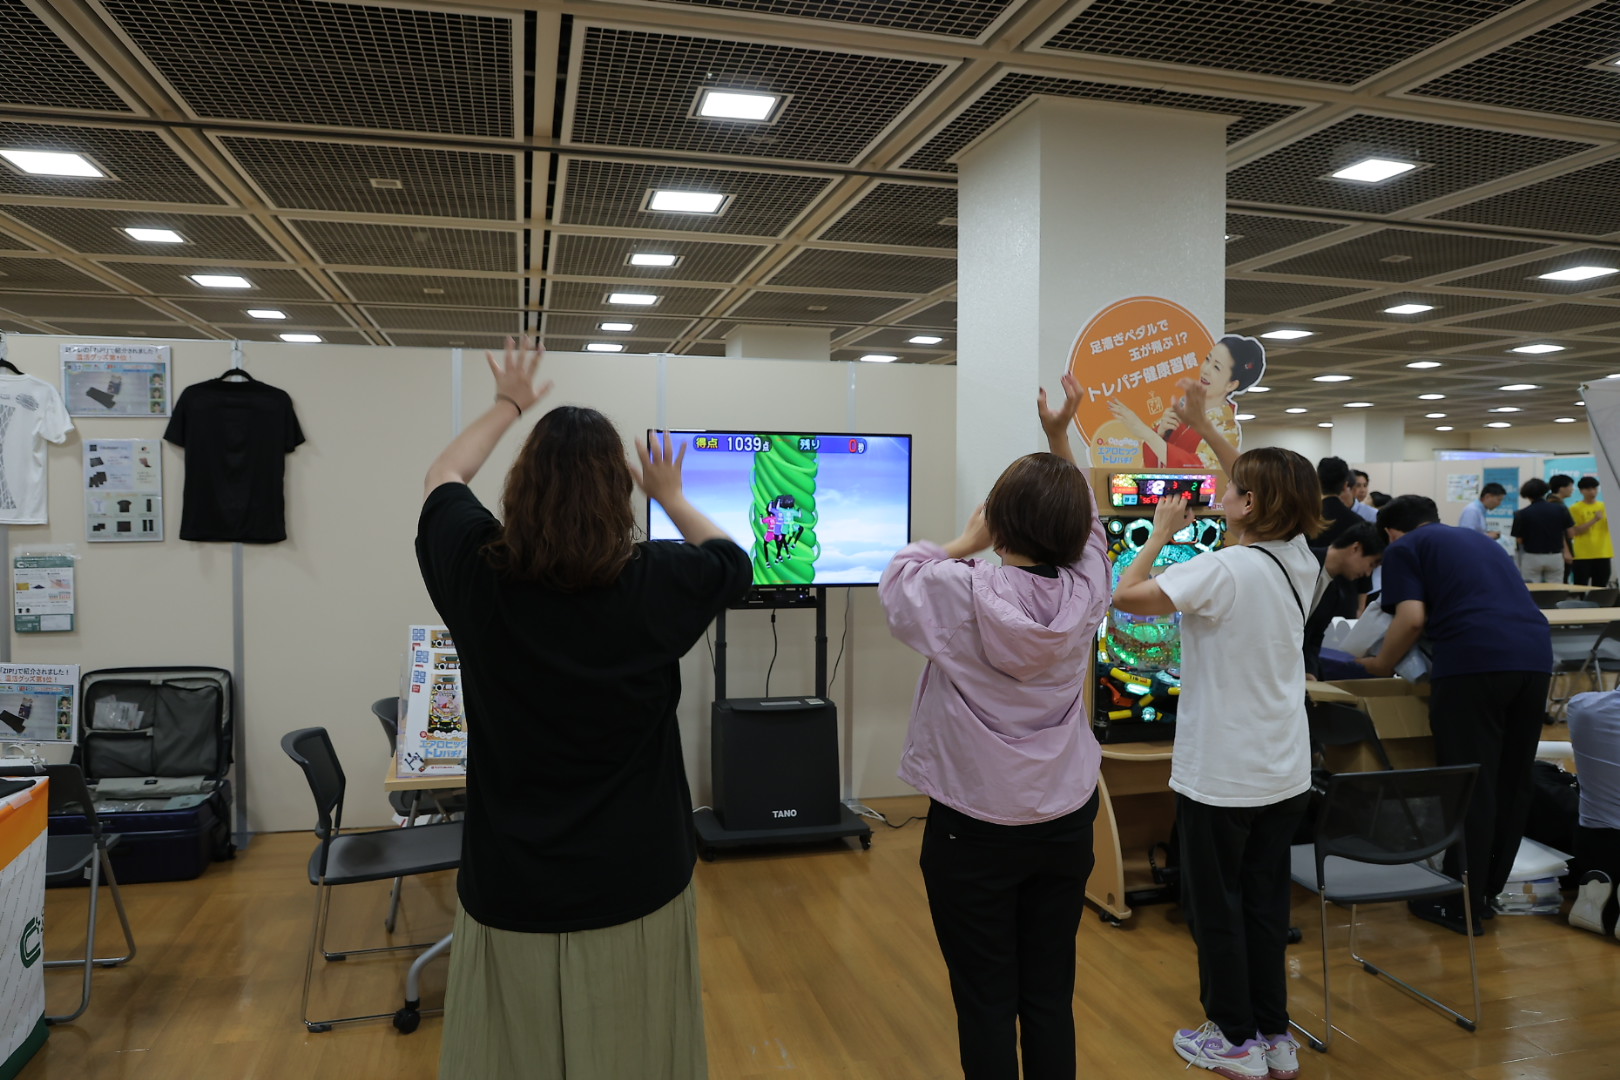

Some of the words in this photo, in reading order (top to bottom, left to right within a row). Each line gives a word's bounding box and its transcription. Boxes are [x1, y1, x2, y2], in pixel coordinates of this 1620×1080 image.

[1090, 319, 1169, 355] 足漕ぎペダルで
[1087, 351, 1199, 402] トレパチ健康習慣
[696, 437, 719, 449] 得点
[799, 438, 820, 451] 残り
[772, 809, 797, 818] TANO
